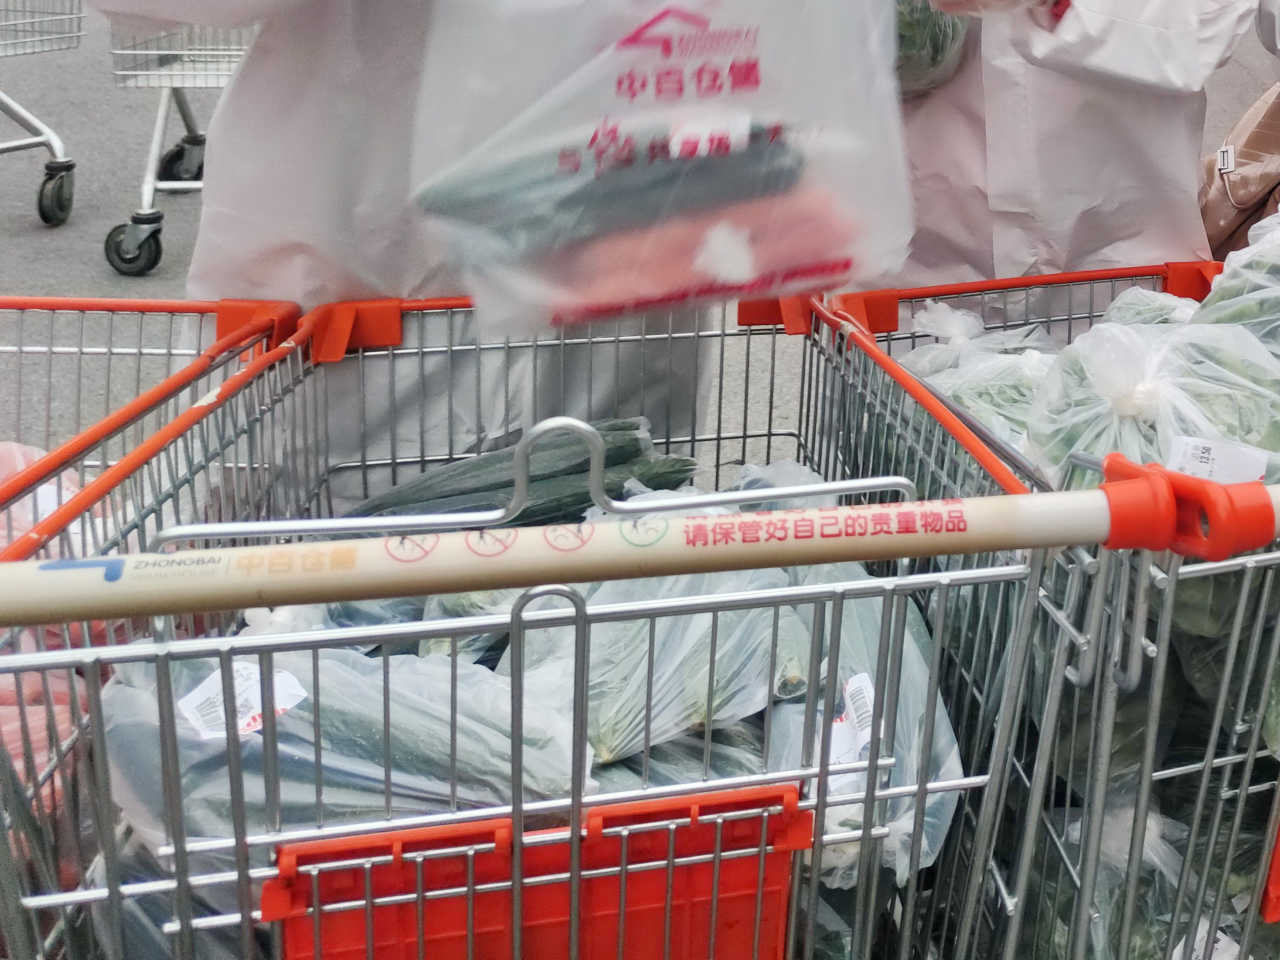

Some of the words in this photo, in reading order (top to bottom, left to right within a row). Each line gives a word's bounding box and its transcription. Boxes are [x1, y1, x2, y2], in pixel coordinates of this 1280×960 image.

[683, 509, 968, 548] 请保管好自己的贵重物品
[132, 555, 223, 571] ZHONGBAI
